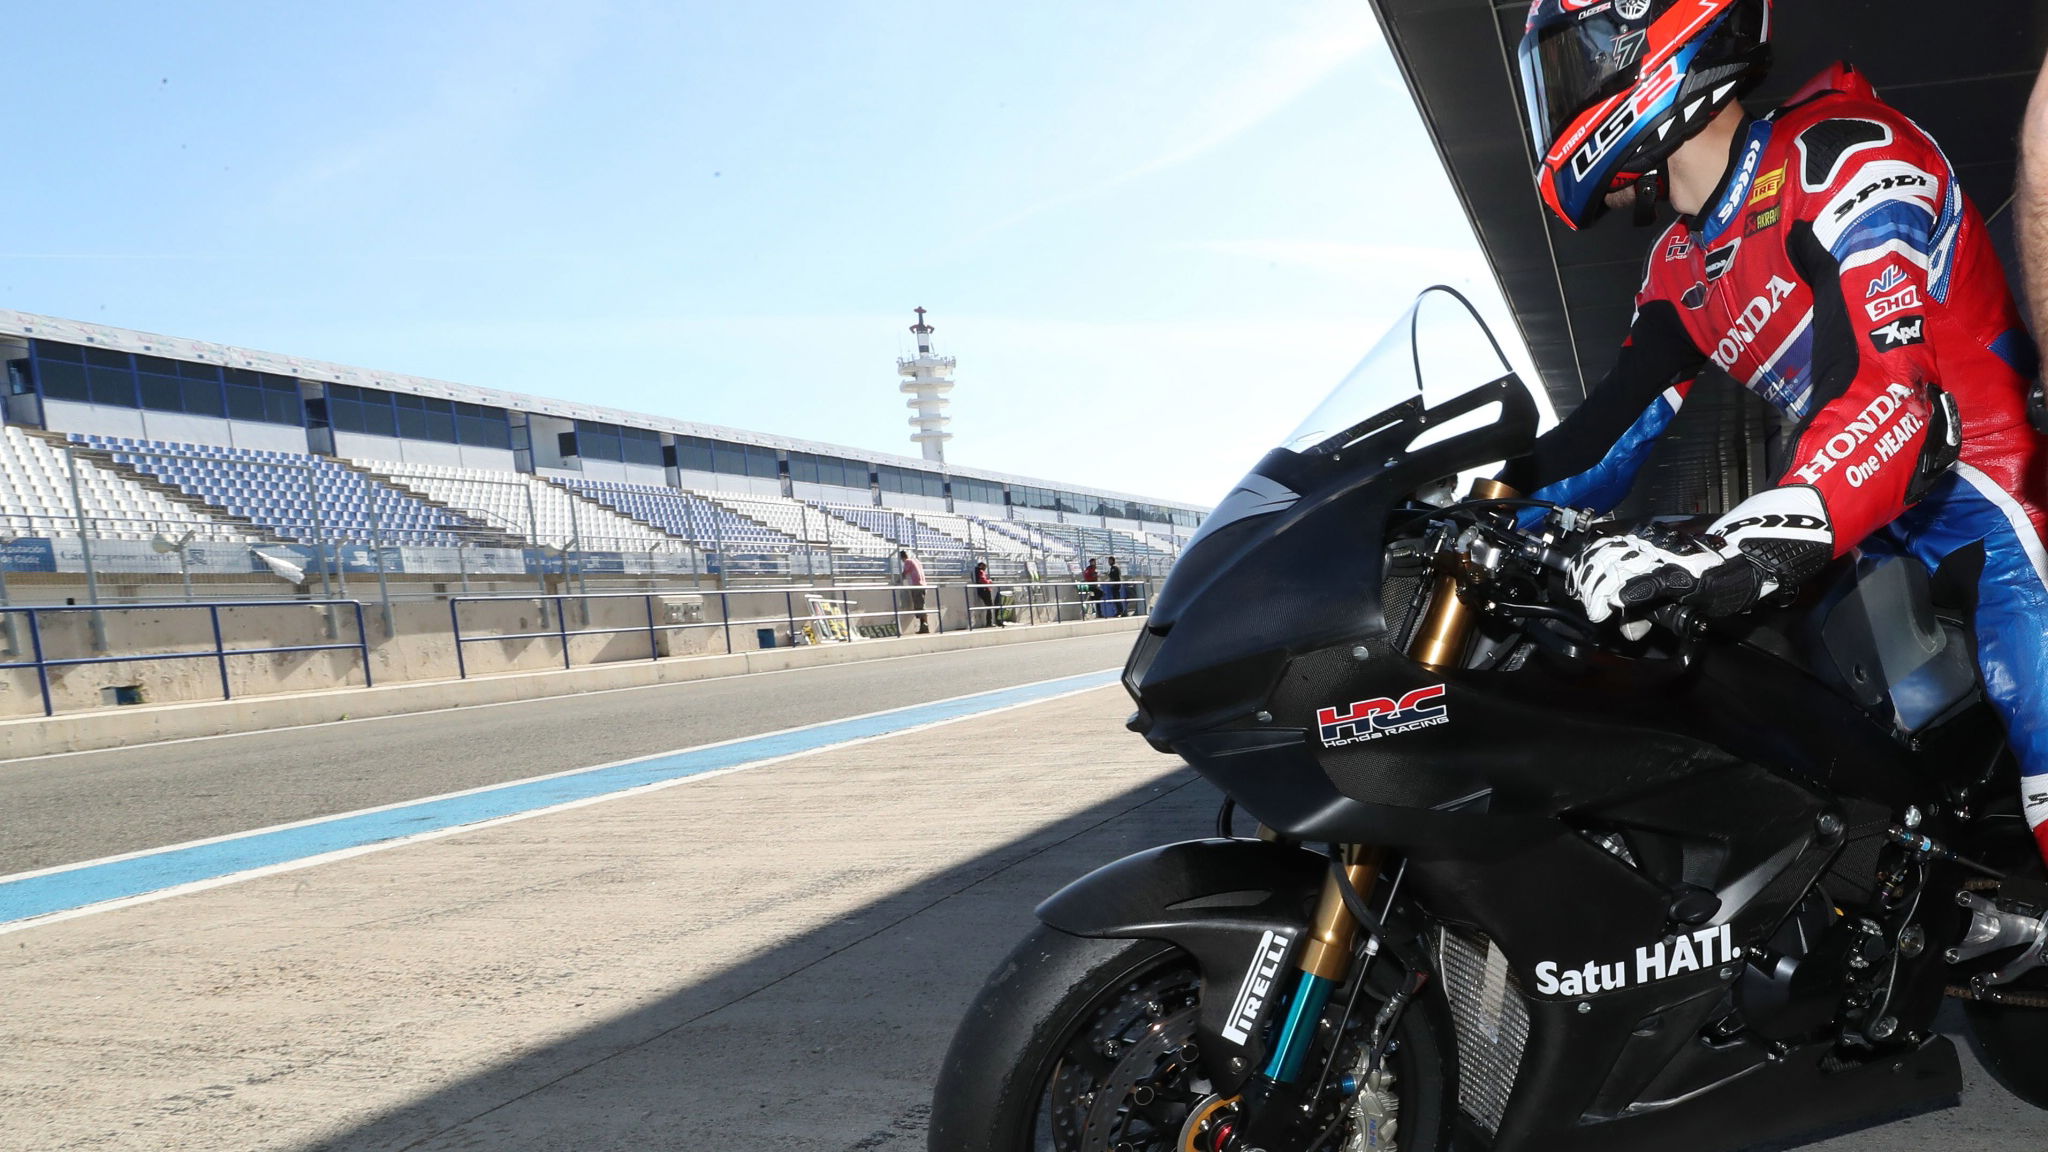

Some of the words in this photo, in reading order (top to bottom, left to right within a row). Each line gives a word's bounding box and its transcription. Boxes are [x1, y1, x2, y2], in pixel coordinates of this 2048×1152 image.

[1718, 139, 1761, 225] SPIDI
[1833, 174, 1927, 223] SPIDI
[1793, 382, 1914, 485] HONDA
[1845, 455, 1881, 488] One
[1317, 683, 1446, 742] HRC
[1323, 732, 1383, 748] Honda
[1384, 716, 1450, 736] RACING
[1221, 930, 1289, 1046] PIRELLI
[1535, 960, 1626, 996] Satu
[1636, 923, 1741, 984] HATI.
